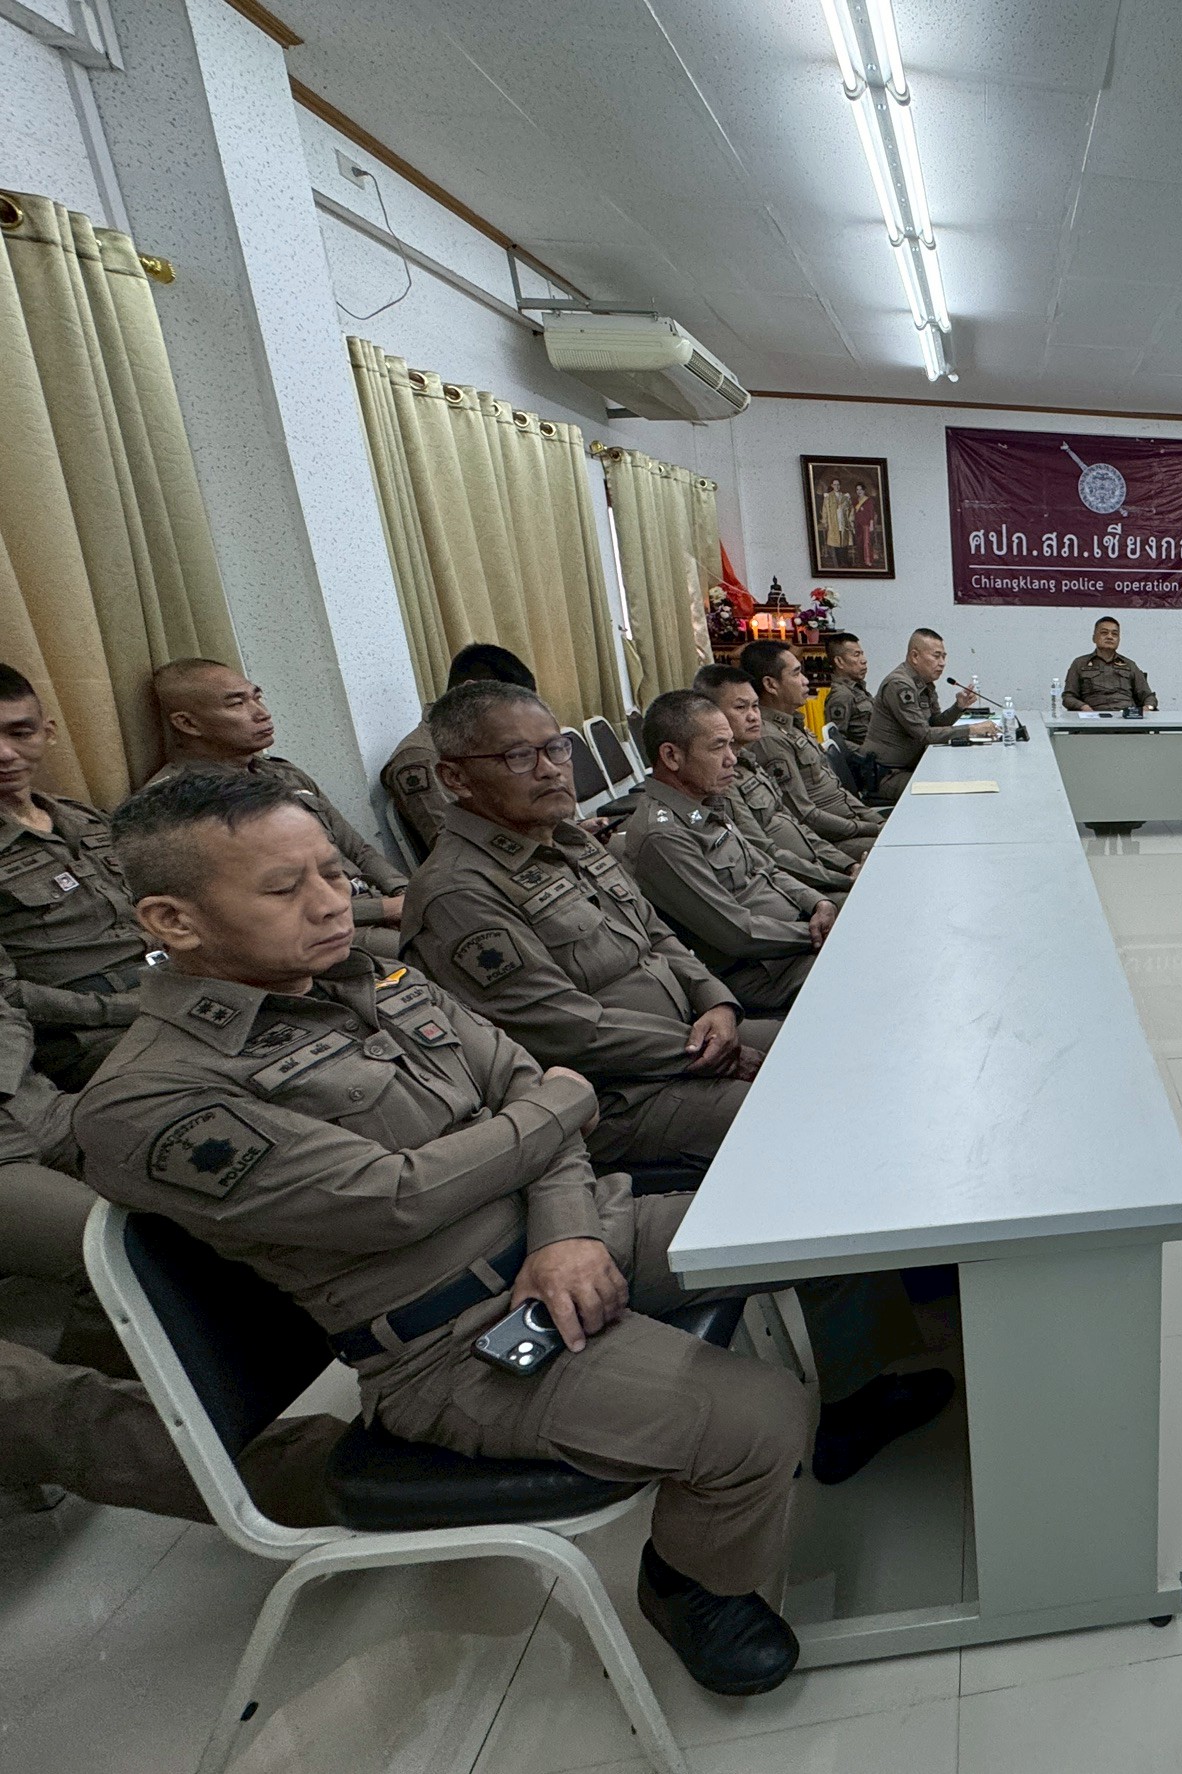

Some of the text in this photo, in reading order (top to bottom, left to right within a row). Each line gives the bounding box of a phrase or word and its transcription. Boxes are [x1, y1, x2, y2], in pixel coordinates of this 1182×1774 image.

[971, 575, 1056, 592] Chiangklang
[1062, 577, 1104, 592] police
[1115, 579, 1179, 593] operation
[486, 961, 516, 981] POLICE
[217, 1146, 261, 1187] POLICE
